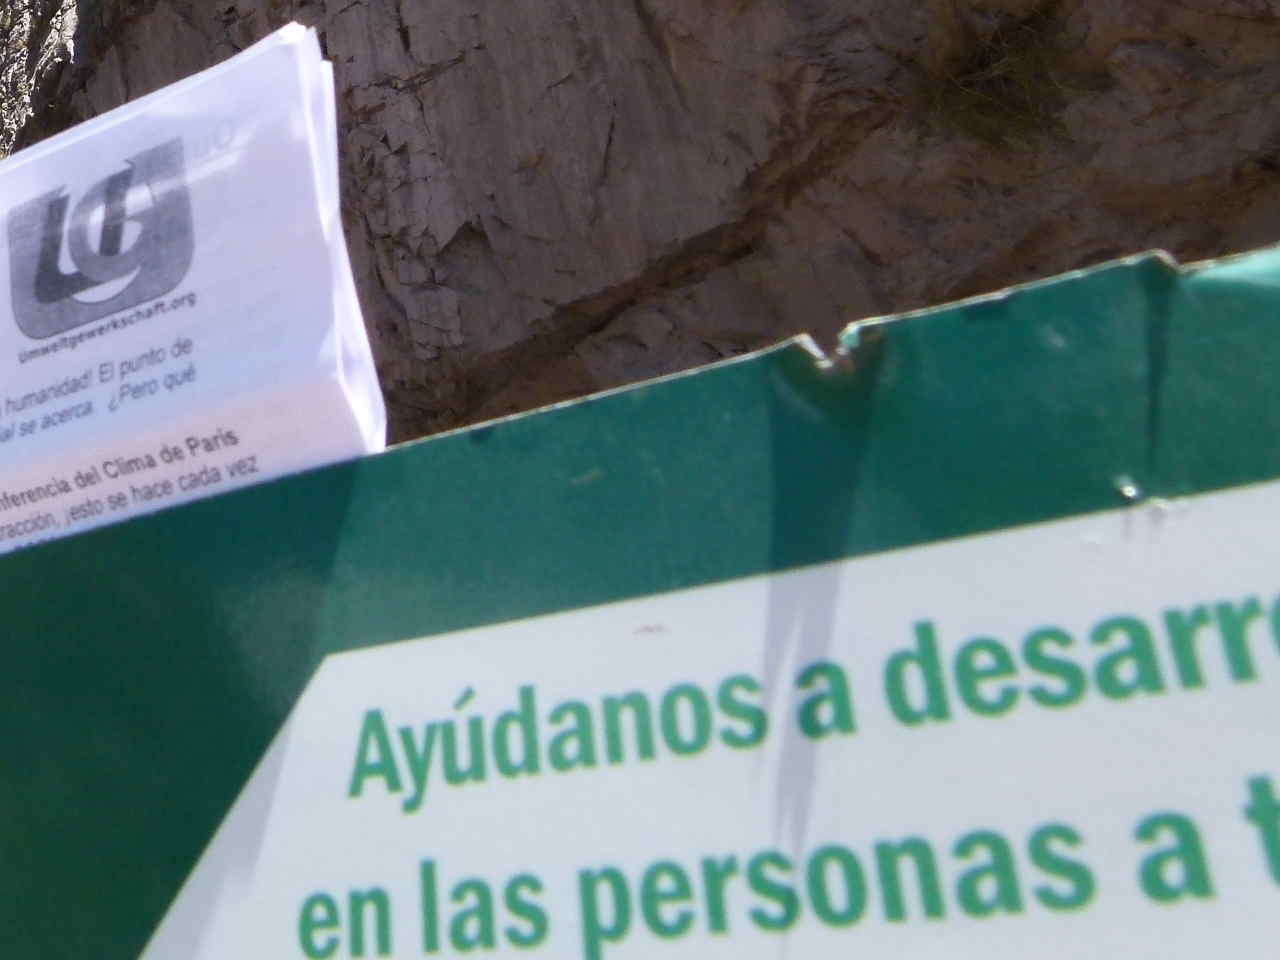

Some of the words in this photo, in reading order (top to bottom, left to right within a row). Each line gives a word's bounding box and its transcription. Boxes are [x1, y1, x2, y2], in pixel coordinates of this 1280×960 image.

[98, 362, 114, 383] El
[120, 347, 166, 380] punto
[170, 338, 193, 359] de
[20, 418, 37, 438] se
[108, 378, 159, 413] ¿Pero
[164, 362, 197, 392] qué
[73, 465, 102, 489] del
[102, 452, 157, 480] Clima
[159, 443, 186, 464] de
[106, 490, 129, 511] se
[131, 479, 174, 502] hace
[177, 465, 223, 492] cada
[225, 454, 261, 478] vez
[347, 673, 770, 816] Ayúdanos
[794, 656, 858, 741] a
[882, 593, 1280, 727] desarr
[297, 883, 393, 960] en
[418, 859, 550, 956] las
[577, 822, 1100, 960] personas
[1134, 810, 1215, 904] a
